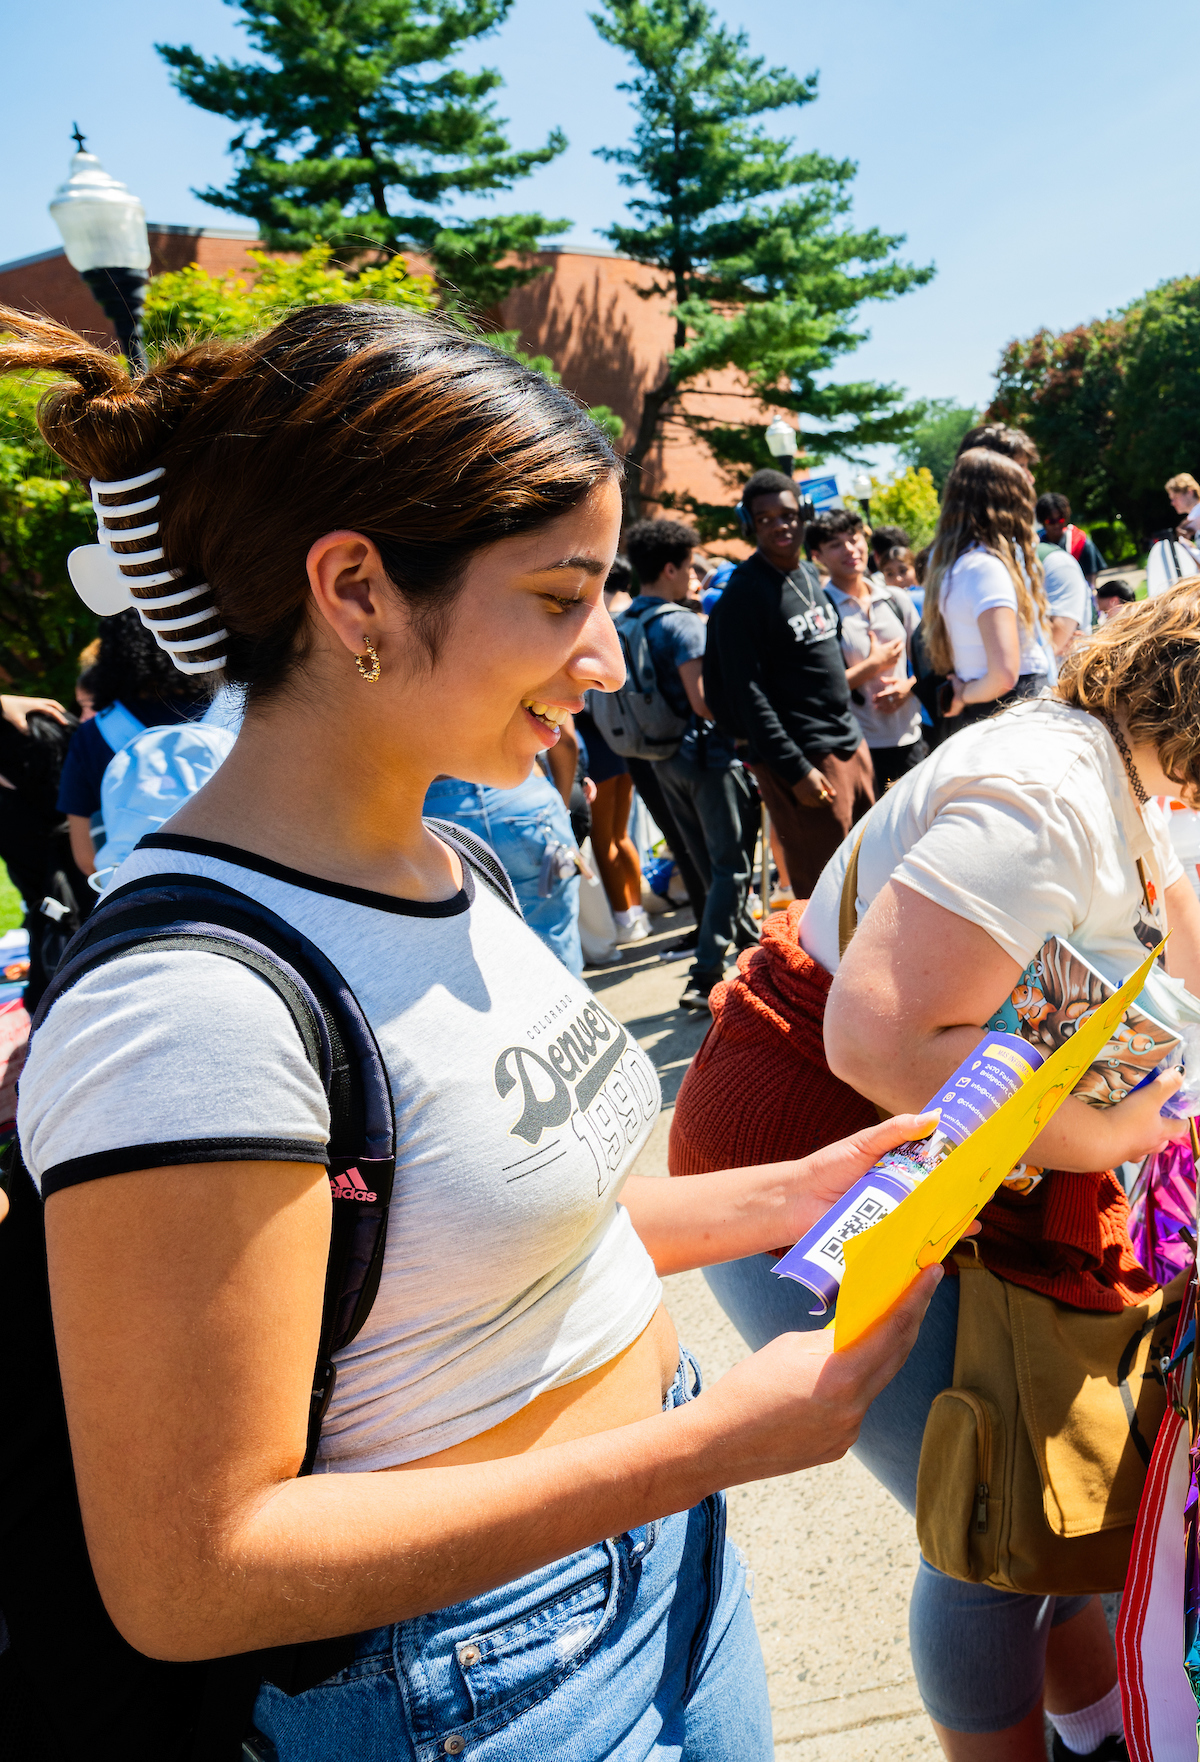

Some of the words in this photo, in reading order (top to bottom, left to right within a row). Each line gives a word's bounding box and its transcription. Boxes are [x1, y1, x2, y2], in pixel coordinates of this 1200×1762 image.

[527, 994, 573, 1041] COLORADO
[493, 998, 628, 1148] Denver
[980, 1069, 1009, 1095] Bridgeport,
[984, 1063, 1000, 1074] 2470
[571, 1047, 662, 1198] 1990
[331, 1186, 378, 1202] didas
